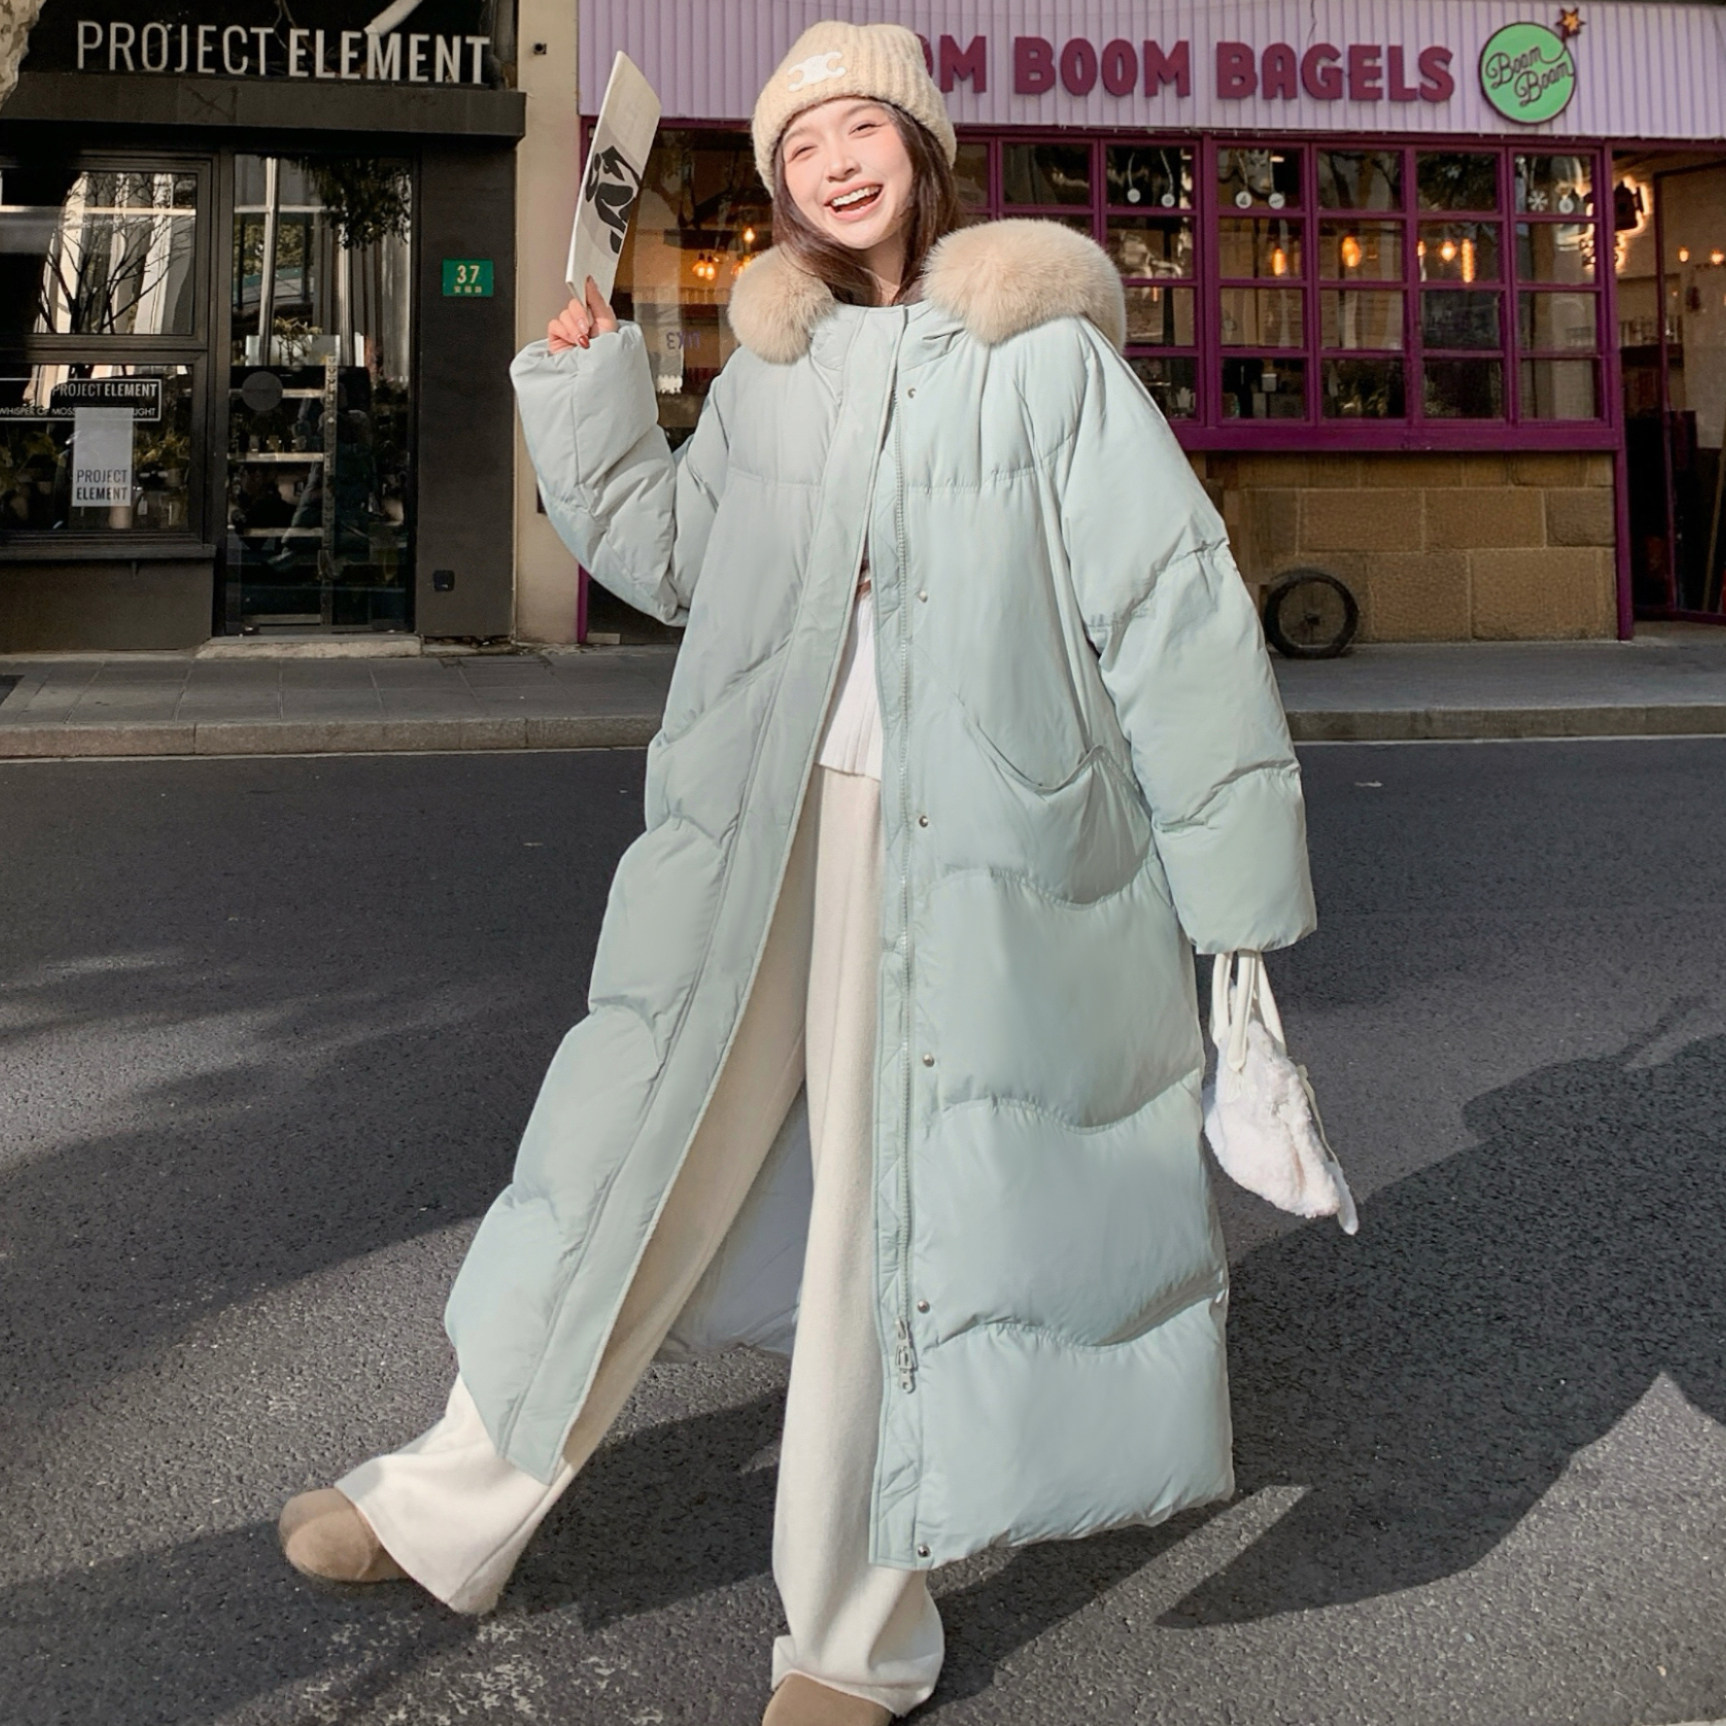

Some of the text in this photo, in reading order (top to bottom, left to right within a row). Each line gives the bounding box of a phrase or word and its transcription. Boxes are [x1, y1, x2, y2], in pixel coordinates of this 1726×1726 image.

[77, 20, 490, 85] PROJECT ELEMENT
[1485, 46, 1542, 90] Boom
[1014, 36, 1191, 98] BOOM
[1216, 41, 1455, 103] BAGELS
[1514, 61, 1570, 108] Boom
[457, 264, 480, 284] 37
[52, 382, 157, 397] PROJECT ELEMENT
[77, 469, 128, 483] PROJECT
[76, 487, 127, 500] ELEMENT
